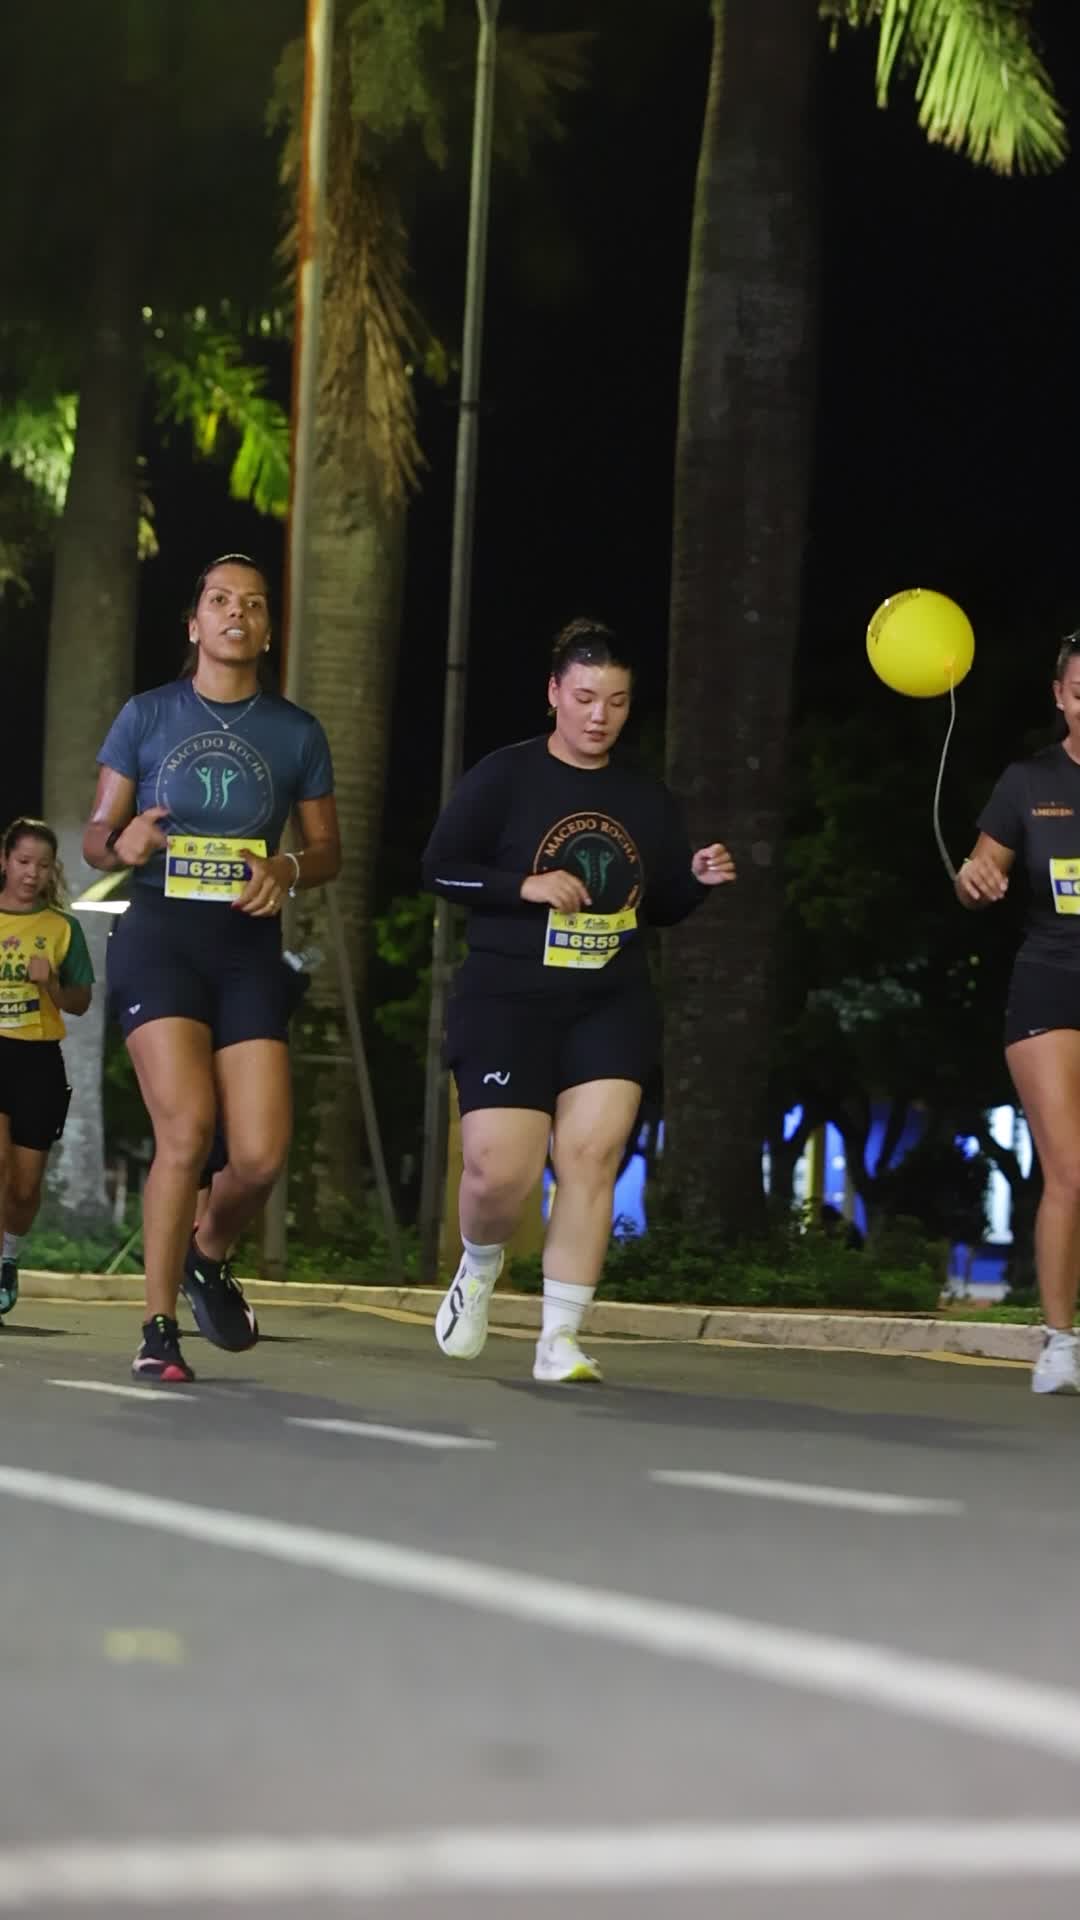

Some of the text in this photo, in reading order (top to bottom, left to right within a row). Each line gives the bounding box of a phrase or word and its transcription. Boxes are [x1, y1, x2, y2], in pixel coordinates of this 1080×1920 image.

[167, 738, 265, 781] MACEDO ROCHA
[544, 819, 636, 864] MACEDO ROCHA
[190, 861, 245, 879] 6233
[569, 934, 619, 950] 6559
